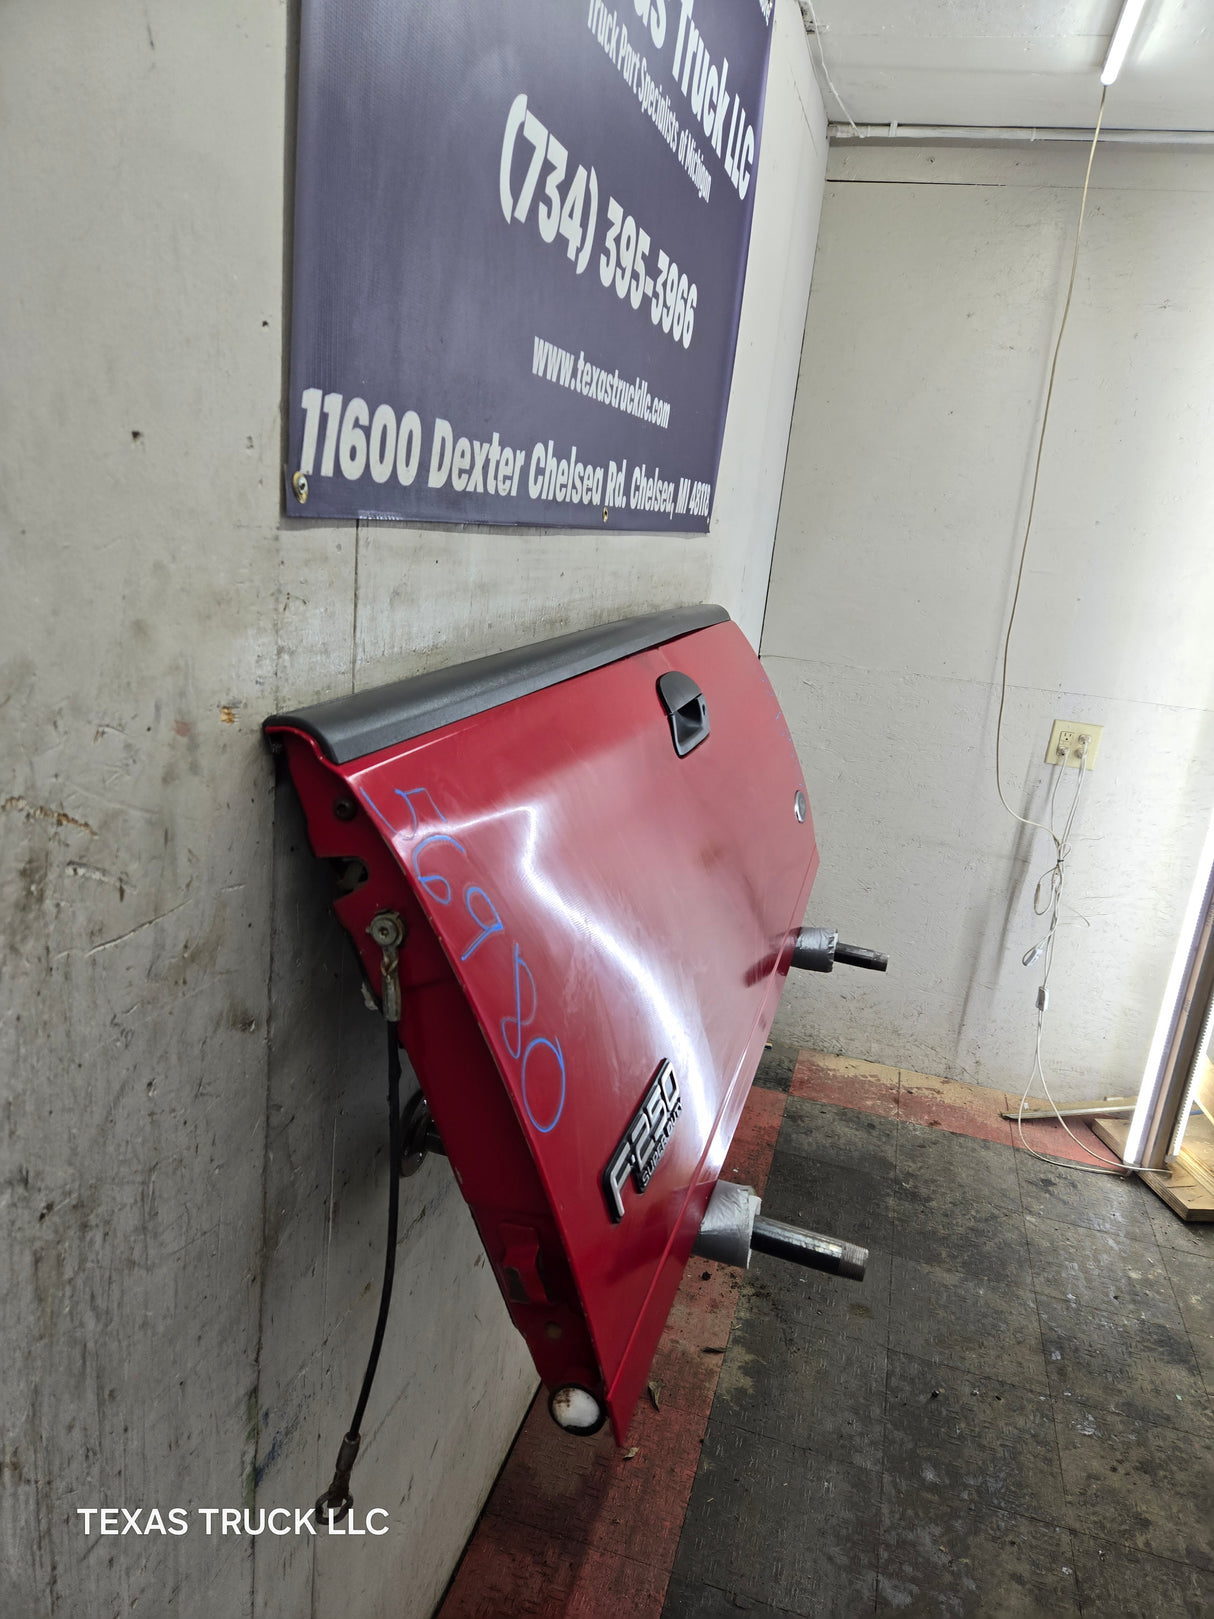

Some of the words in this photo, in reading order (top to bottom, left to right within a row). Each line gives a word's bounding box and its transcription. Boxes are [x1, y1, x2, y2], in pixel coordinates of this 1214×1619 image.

[617, 24, 640, 94] Part
[638, 57, 679, 153] Specialists
[678, 129, 689, 166] of
[685, 133, 712, 203] Michigan
[672, 0, 730, 158] Truck
[724, 93, 754, 200] LLC
[500, 93, 599, 275] (734)
[599, 196, 700, 350] 395-3966
[301, 388, 422, 486] 11600
[428, 418, 525, 497] Dexter
[528, 440, 604, 506] Chelsea
[604, 460, 627, 510] Rd.
[630, 464, 674, 520] Chelsea,
[676, 477, 691, 515] MI
[688, 482, 711, 517] 48118
[532, 336, 671, 429] www.texastruckllc.com
